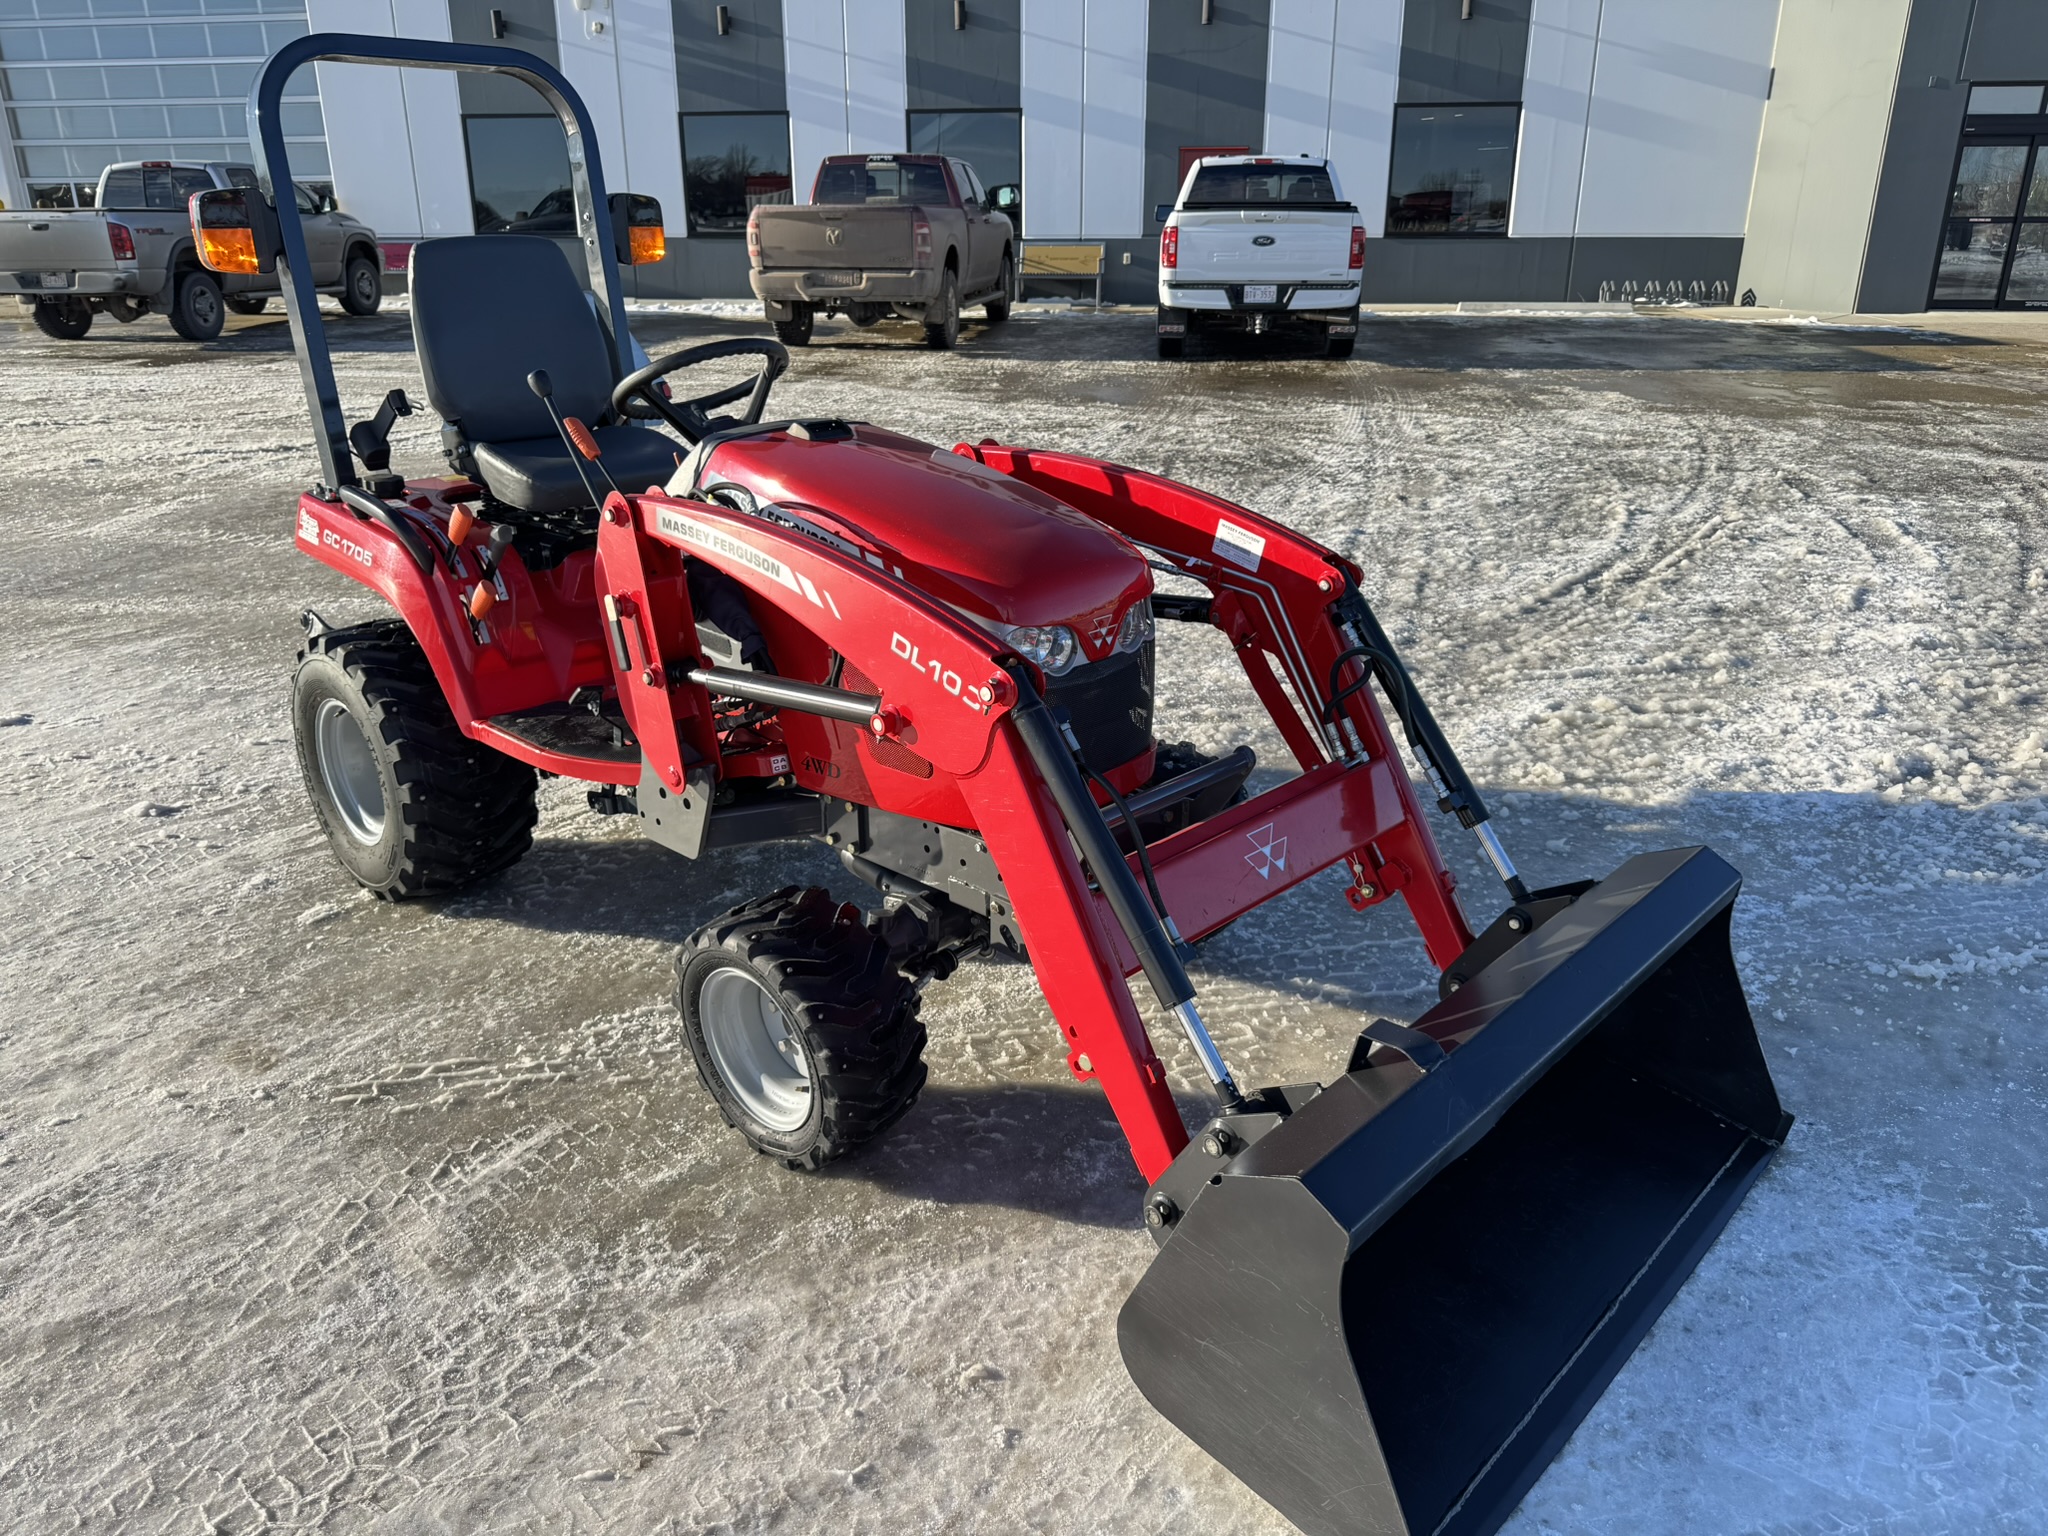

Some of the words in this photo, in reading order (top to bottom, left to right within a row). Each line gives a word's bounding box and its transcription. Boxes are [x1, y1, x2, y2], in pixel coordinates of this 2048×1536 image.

[323, 529, 373, 567] GC1705
[662, 516, 711, 544] MASSEY
[713, 535, 781, 578] FERGUSON
[800, 755, 841, 779] 4WD
